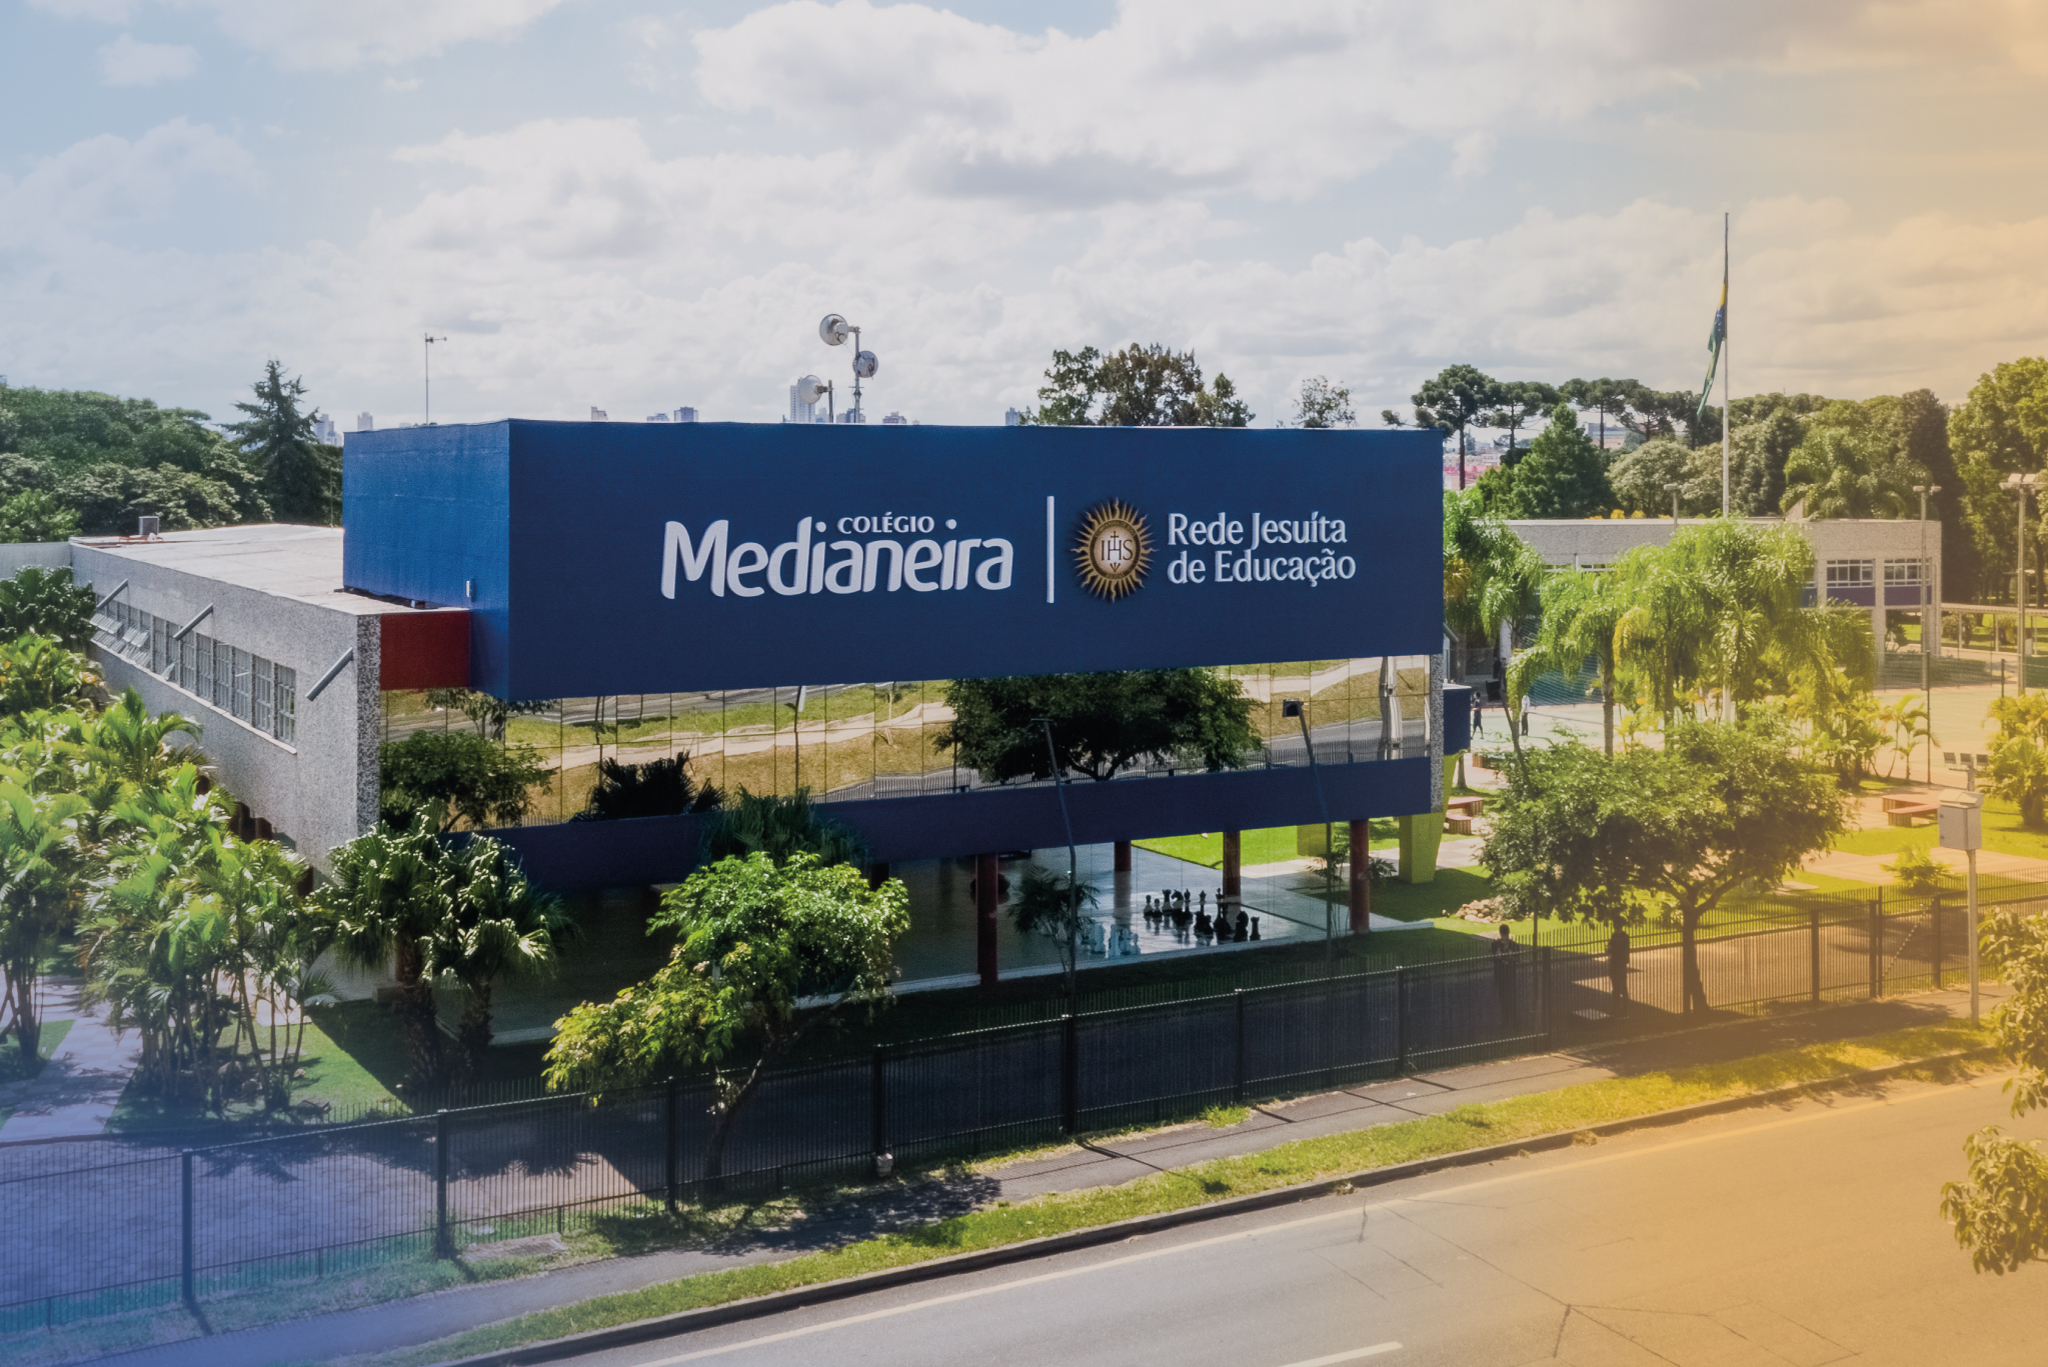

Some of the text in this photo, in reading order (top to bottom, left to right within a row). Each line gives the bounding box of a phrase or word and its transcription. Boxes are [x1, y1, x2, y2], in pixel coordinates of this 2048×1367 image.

[837, 511, 935, 535] COLÉGIO
[1168, 511, 1244, 546] Rede
[1250, 510, 1348, 550] Jesuíta
[660, 516, 1014, 600] Medianeira
[1101, 539, 1133, 561] IHS
[1167, 547, 1357, 588] de Educação
